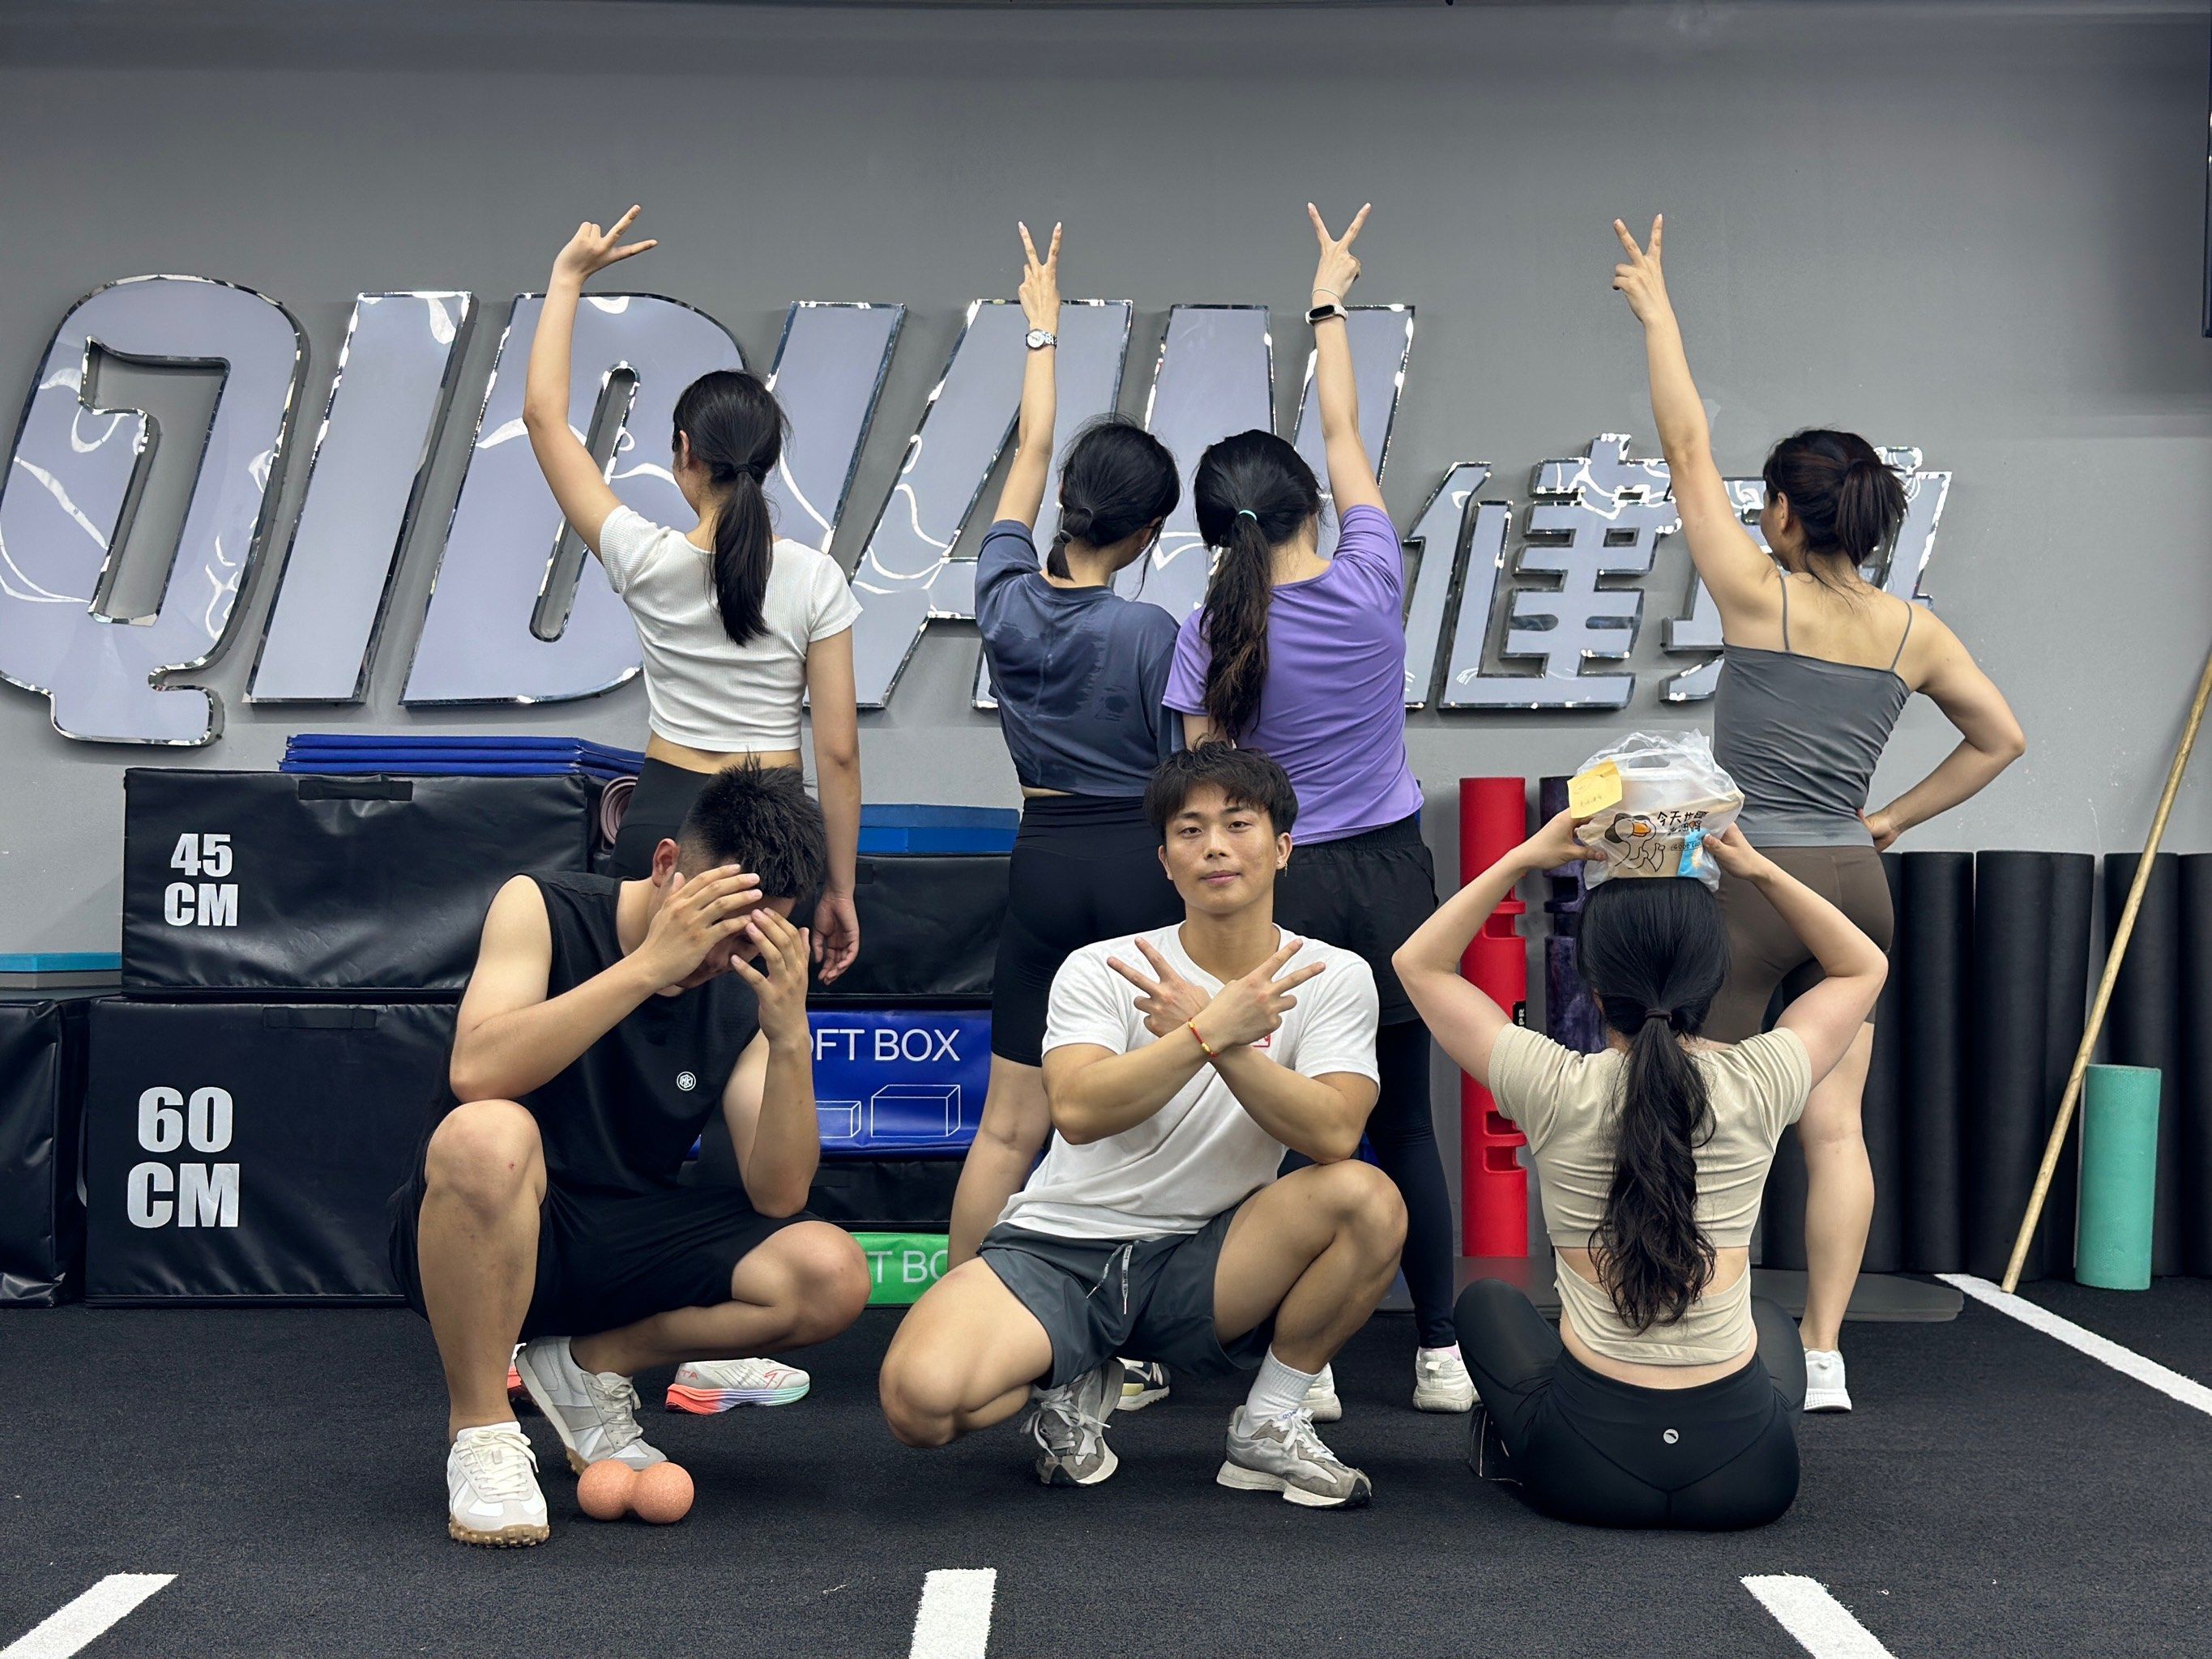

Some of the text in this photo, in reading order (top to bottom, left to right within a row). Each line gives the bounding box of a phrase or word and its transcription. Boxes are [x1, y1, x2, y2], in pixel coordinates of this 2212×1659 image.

[170, 833, 233, 877] 45
[164, 881, 238, 927] CM
[810, 1028, 960, 1061] FT BOX
[138, 1086, 233, 1154] 60
[127, 1162, 240, 1229] CM
